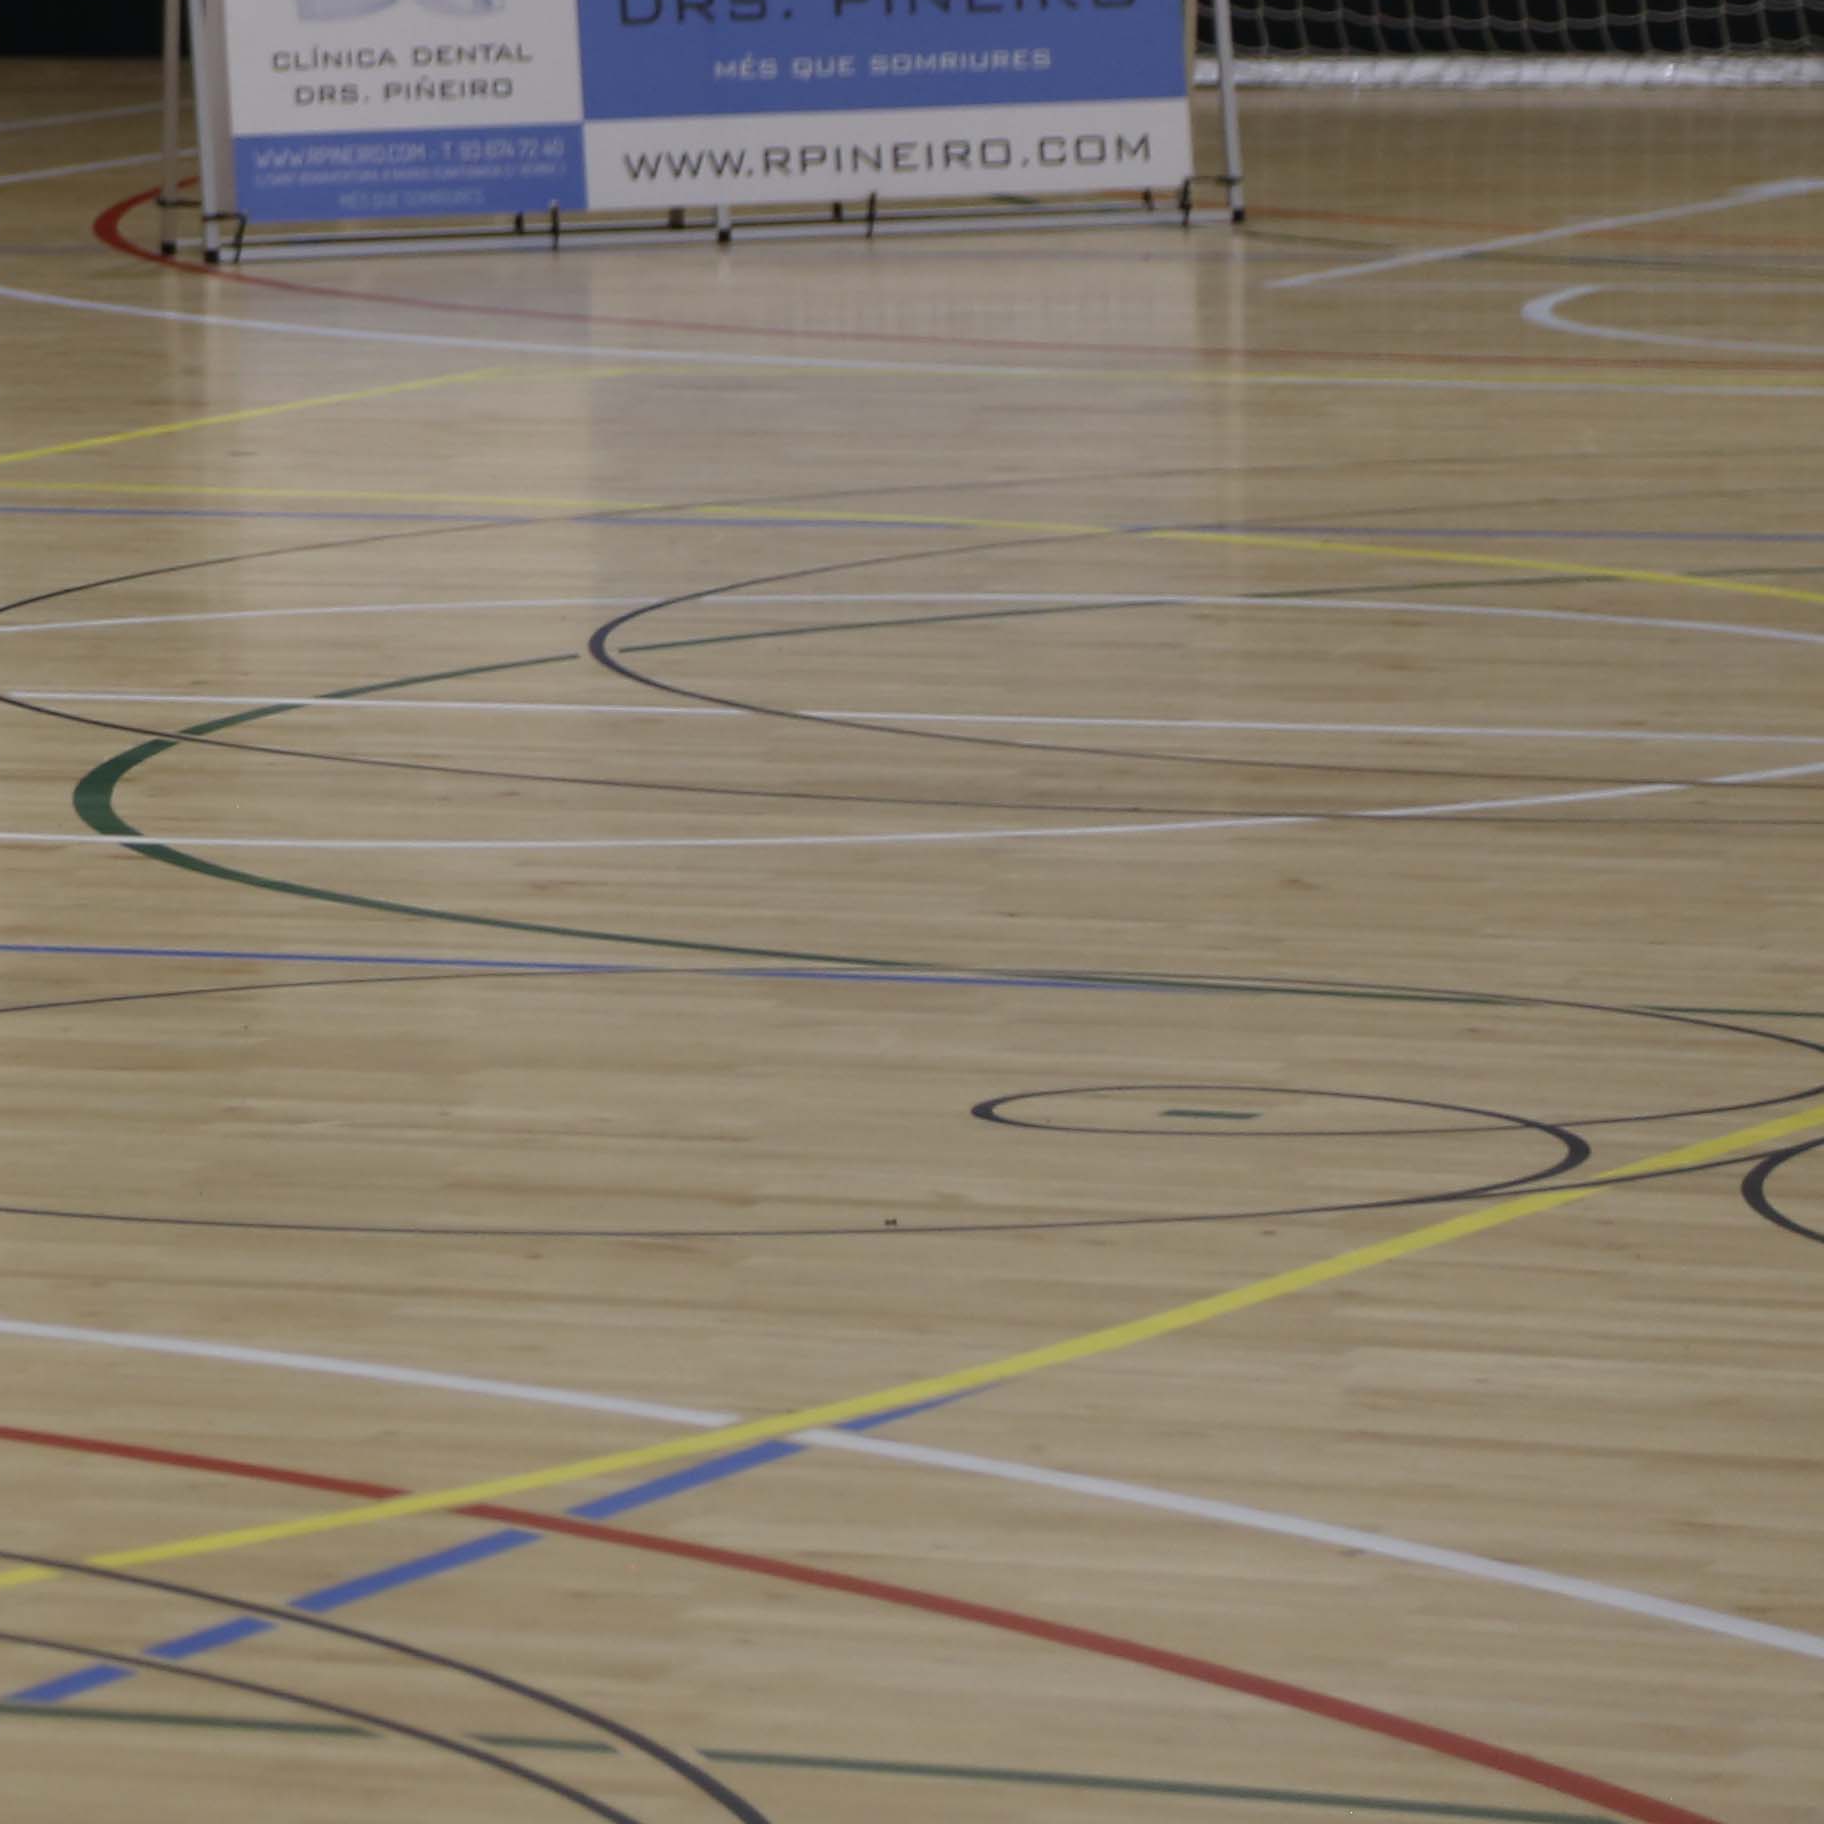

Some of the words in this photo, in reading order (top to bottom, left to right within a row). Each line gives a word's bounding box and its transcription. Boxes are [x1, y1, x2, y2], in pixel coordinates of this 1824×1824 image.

[271, 45, 397, 72] CLÍNICA
[411, 43, 534, 67] DENTAL
[713, 51, 778, 81] MÉS
[791, 55, 856, 81] QUE
[868, 48, 1053, 75] SOMRIURES
[294, 83, 370, 106] DRS.
[383, 75, 514, 102] PIÑEIRO
[622, 133, 1153, 182] WWW.RPINEIRO.COM
